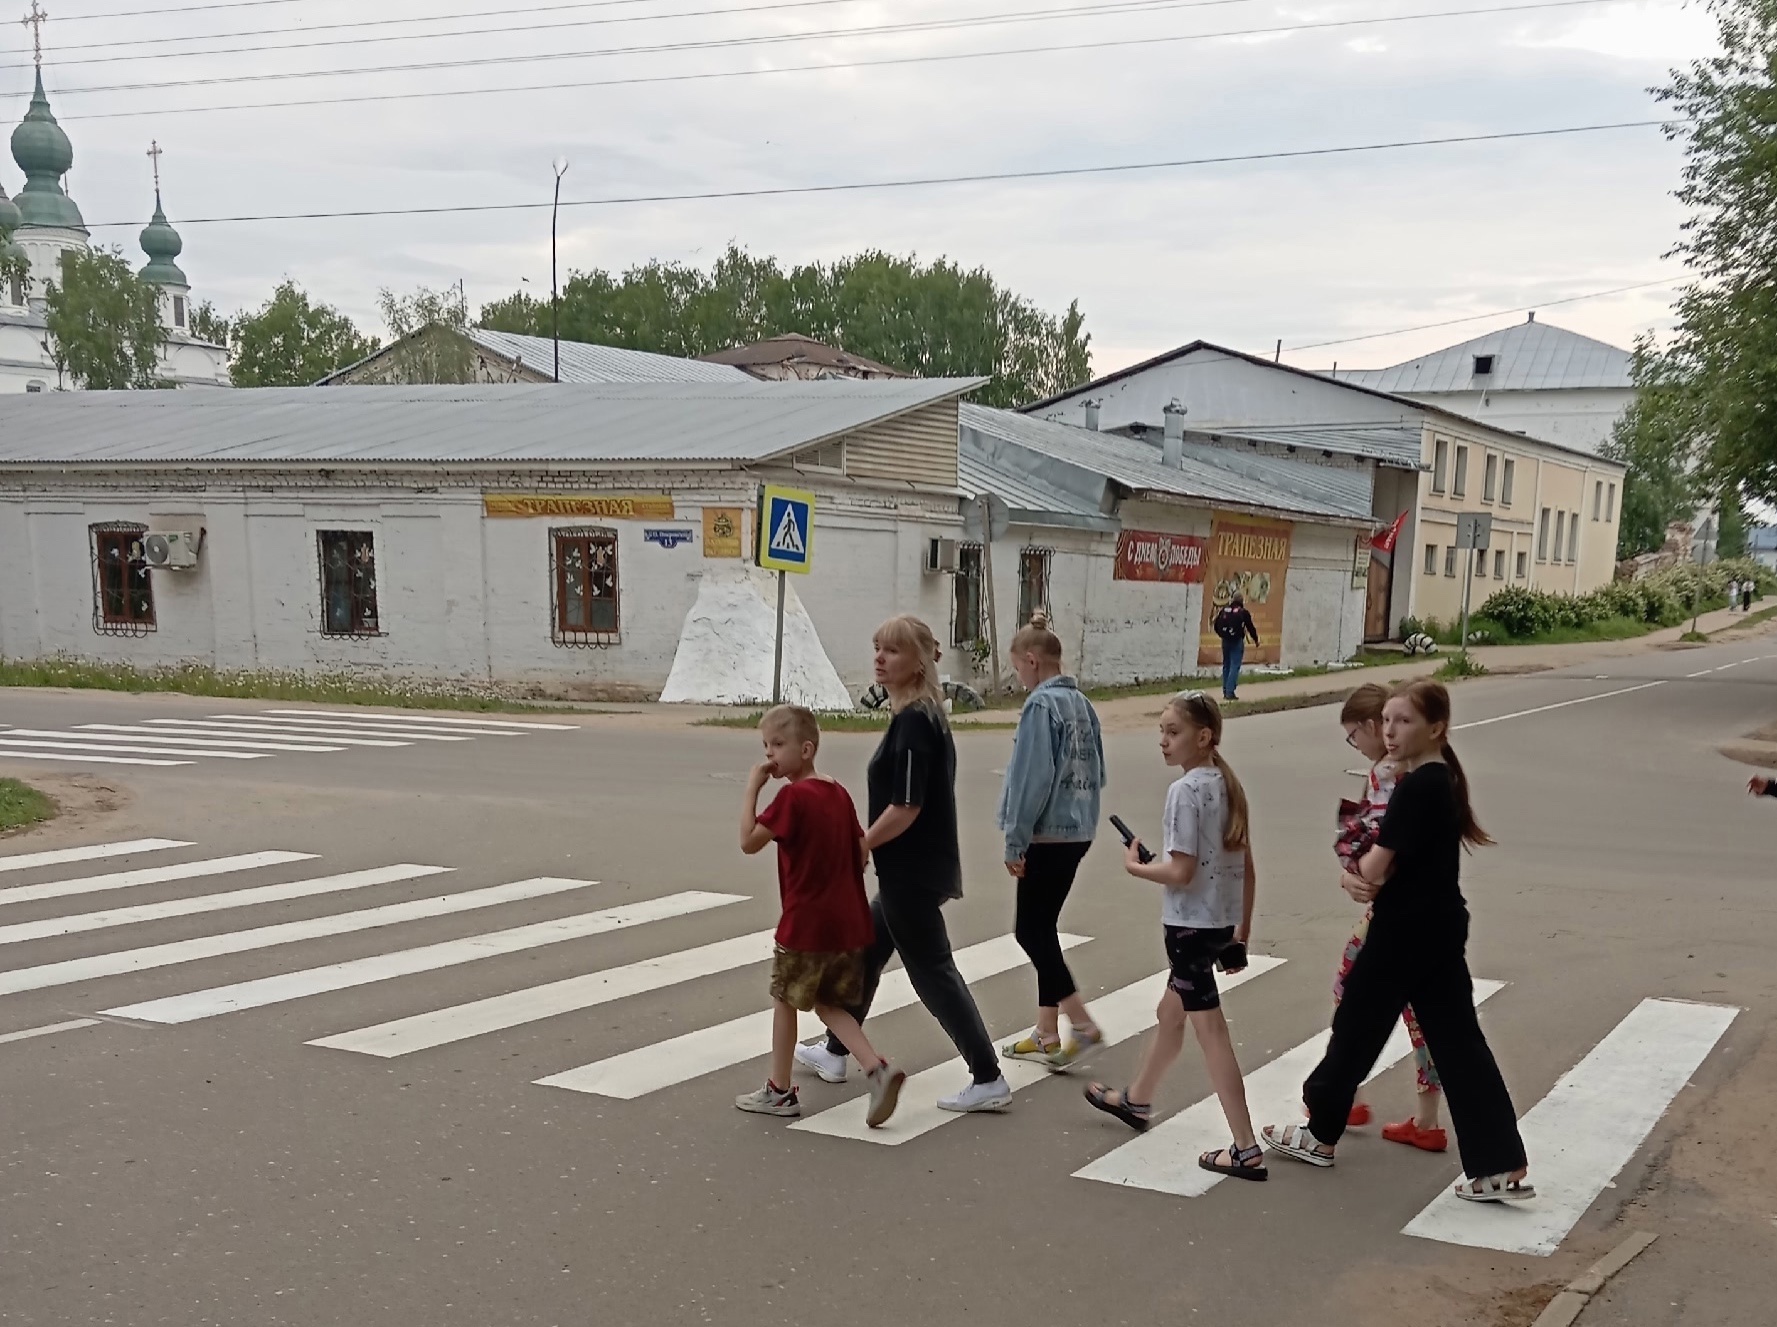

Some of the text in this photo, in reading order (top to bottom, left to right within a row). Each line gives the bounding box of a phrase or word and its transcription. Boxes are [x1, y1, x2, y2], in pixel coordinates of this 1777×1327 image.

[523, 498, 634, 516] ТРАПЕЗНАЯ
[1127, 541, 1201, 569] С ДНЕМ ПОБЕДЫ
[1218, 532, 1287, 560] ТРАПЕЗНАЯ
